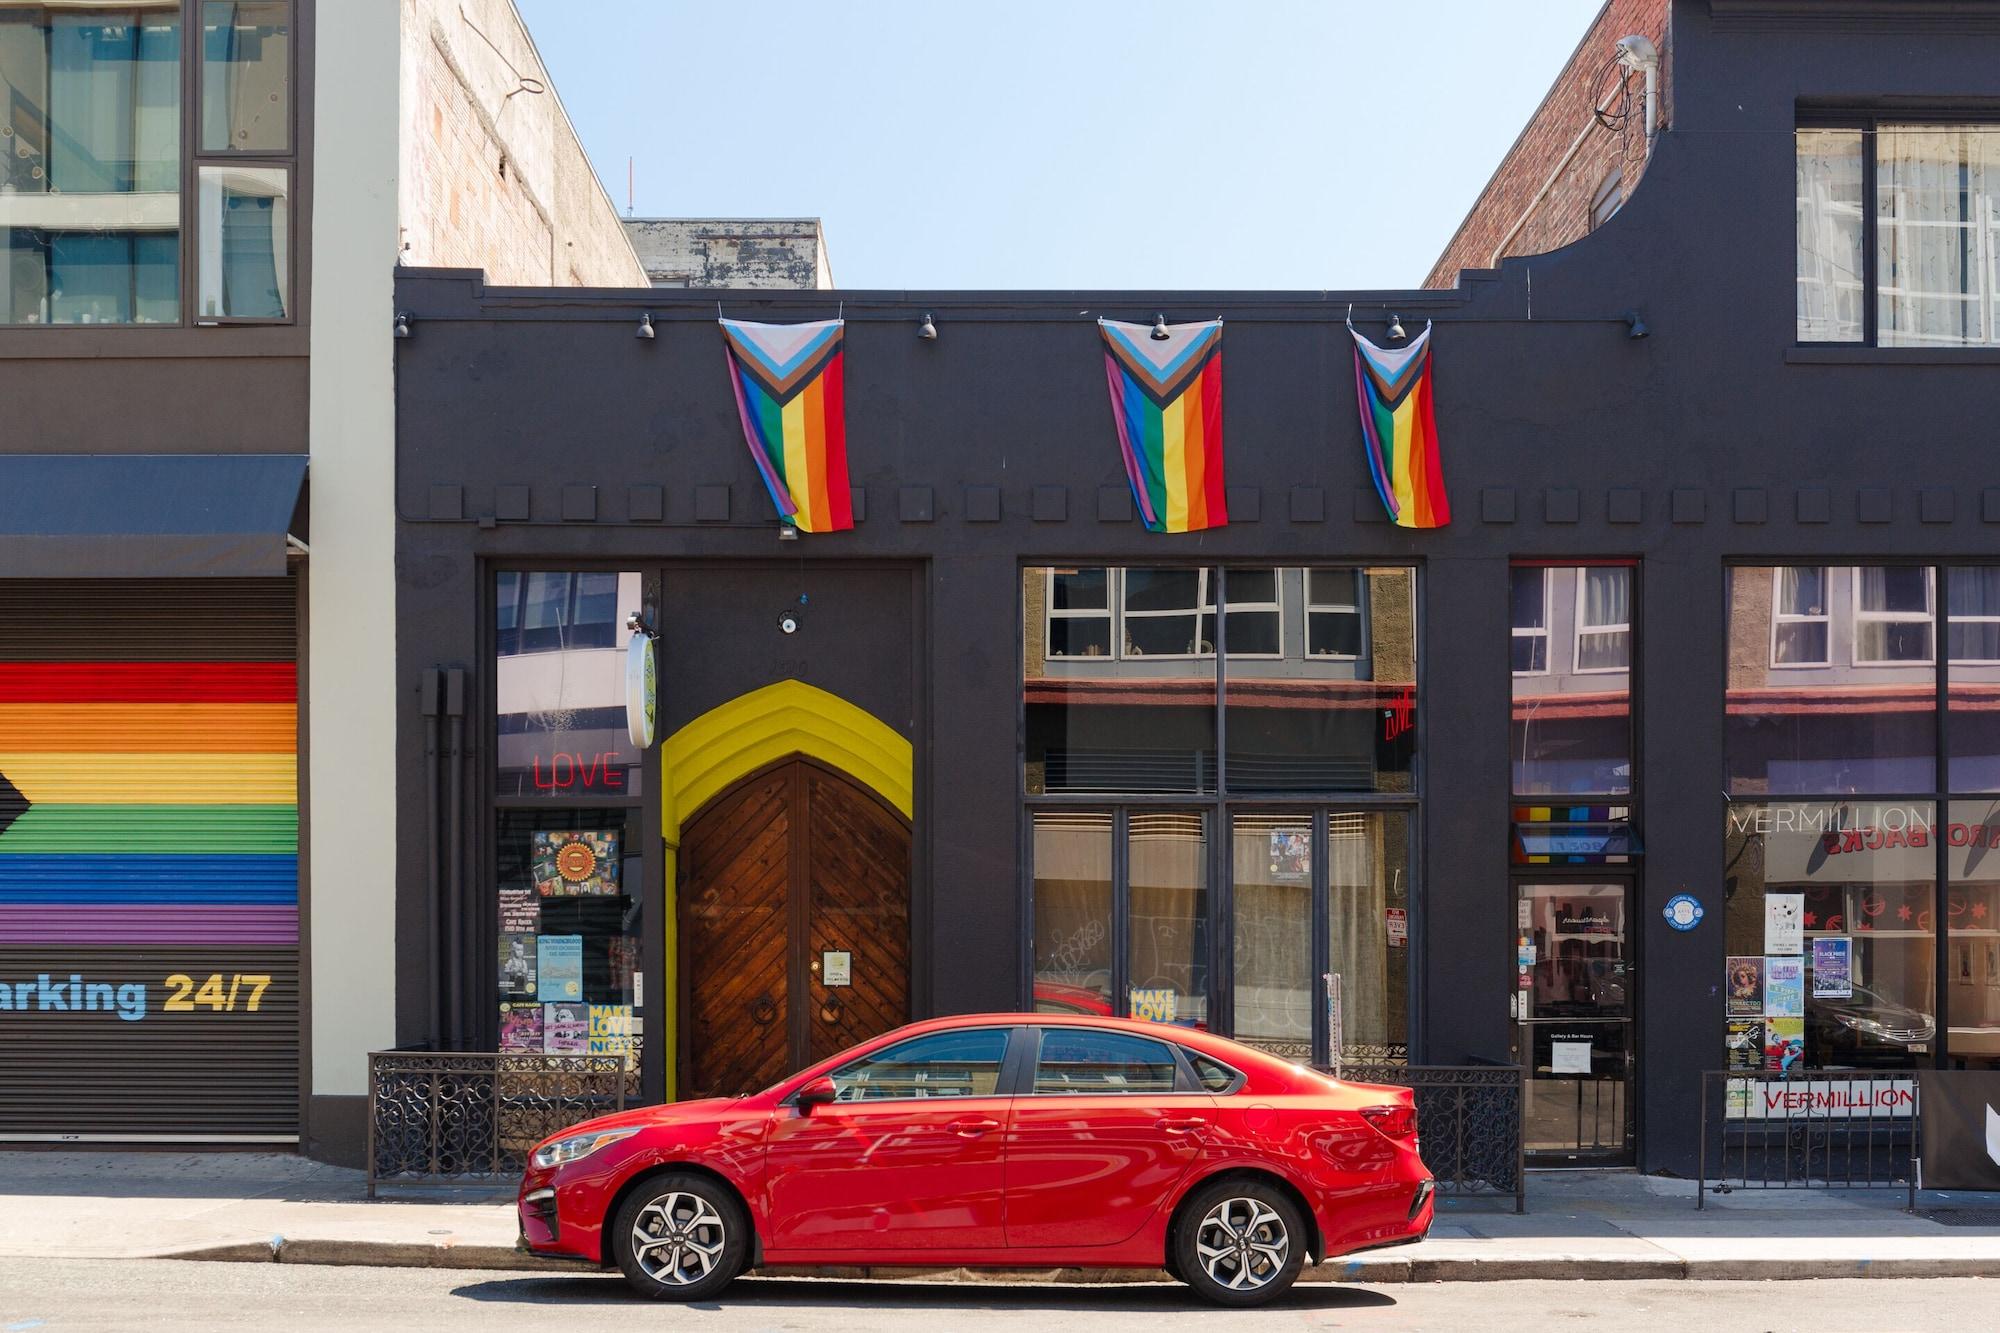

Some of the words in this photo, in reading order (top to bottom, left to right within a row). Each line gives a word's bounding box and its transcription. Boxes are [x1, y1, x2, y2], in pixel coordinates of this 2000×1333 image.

[533, 752, 623, 789] LOVE
[1732, 807, 1932, 833] VERMILLION
[163, 974, 272, 1011] 24/7
[1131, 990, 1174, 1004] MAKE
[590, 1004, 632, 1018] MAKE
[1131, 1001, 1174, 1021] LOVE
[590, 1016, 632, 1036] LOVE
[1764, 1089, 1913, 1110] VERMILLION
